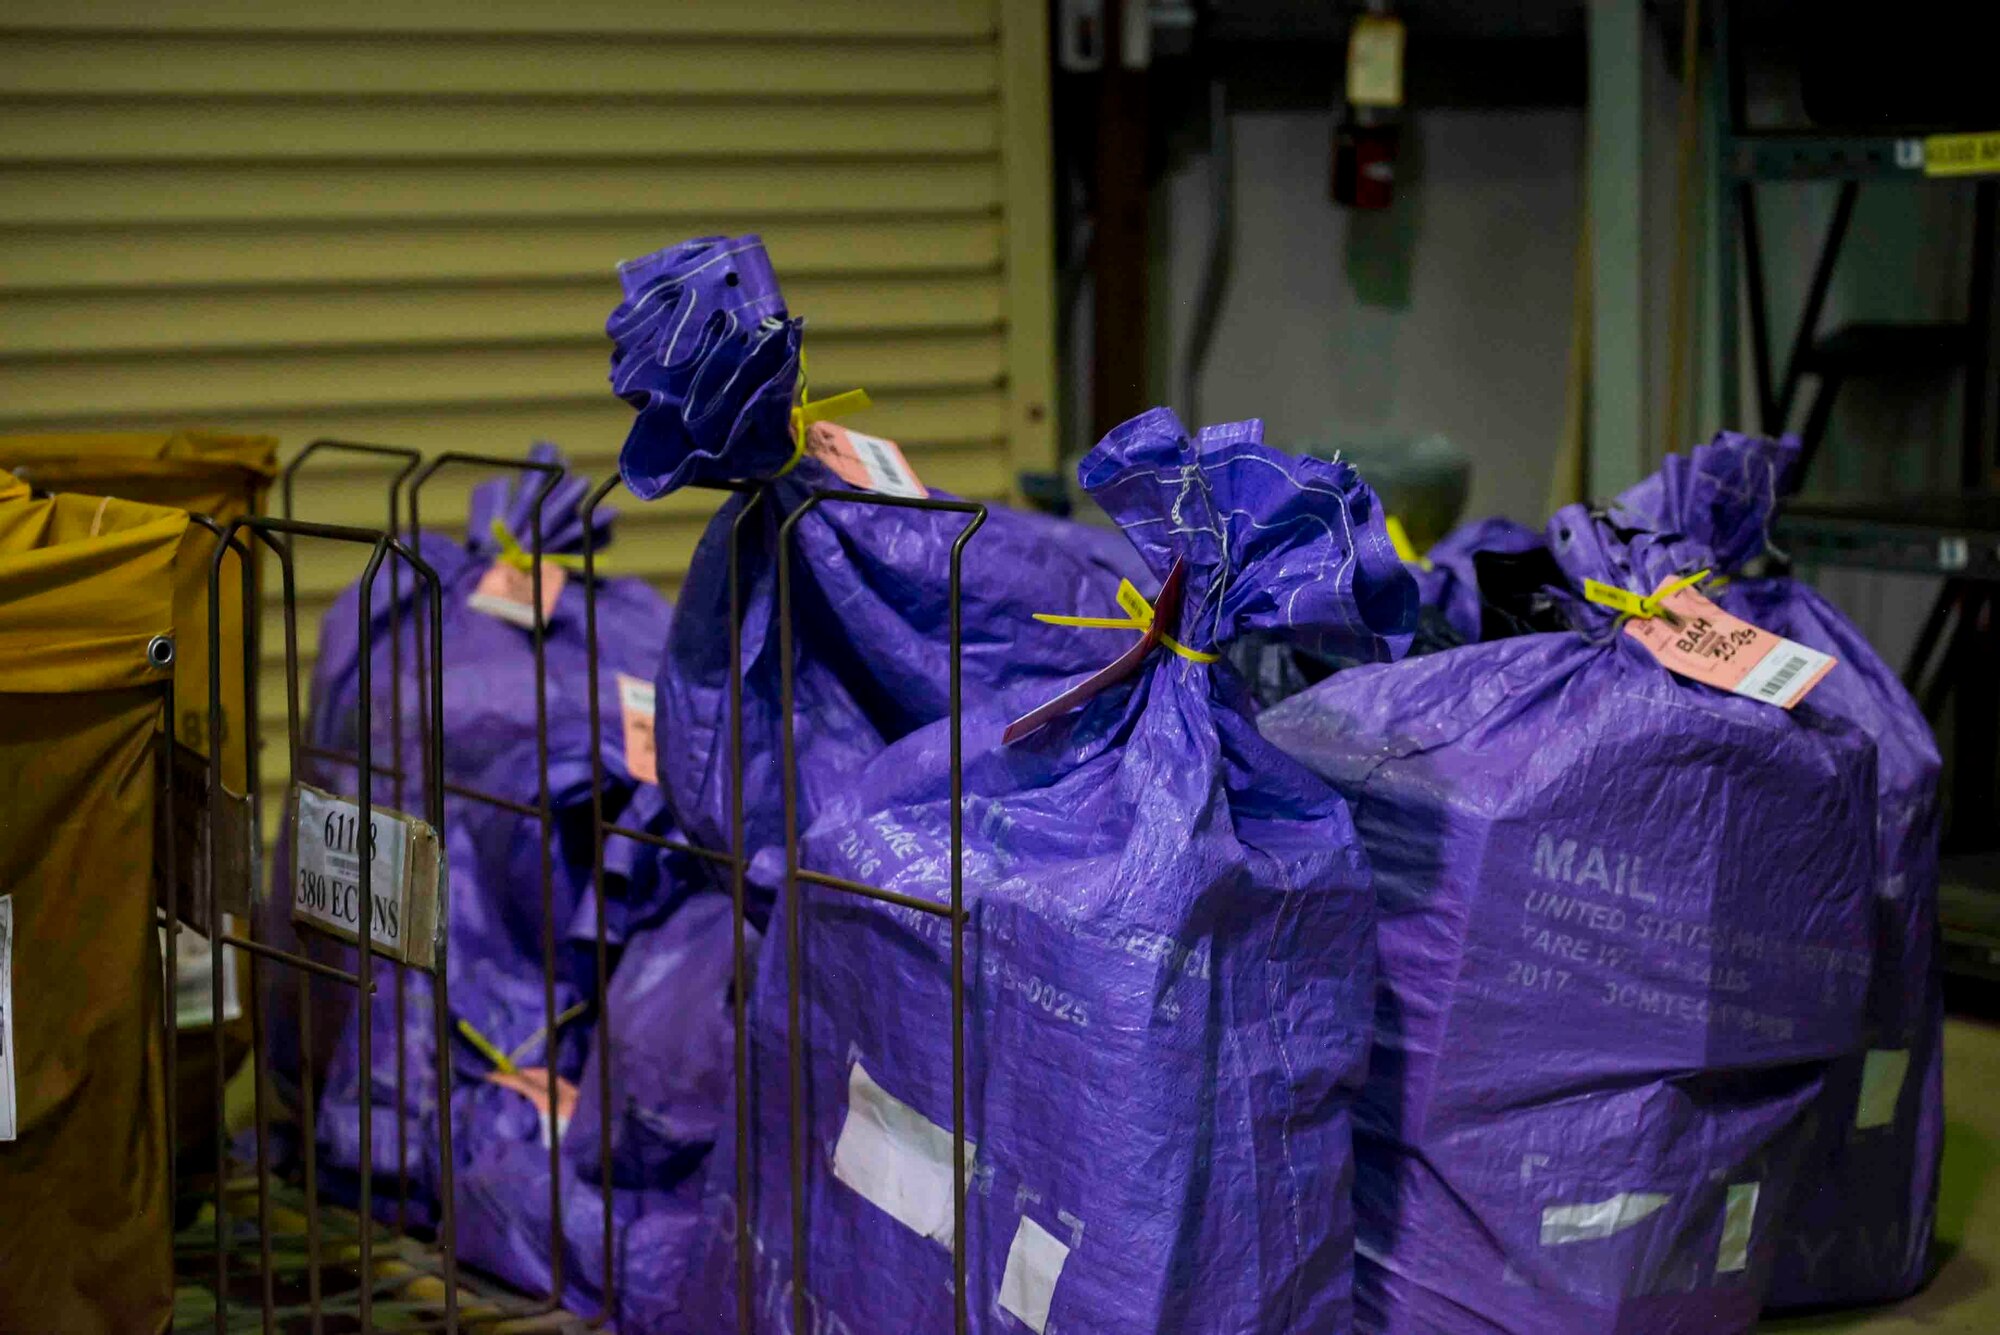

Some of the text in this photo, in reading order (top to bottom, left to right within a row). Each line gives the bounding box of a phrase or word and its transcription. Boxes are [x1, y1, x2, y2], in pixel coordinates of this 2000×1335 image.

[1676, 617, 1712, 653] BAH
[1533, 832, 1657, 903] MAIL
[297, 869, 398, 937] 380 ECNS
[1524, 889, 1627, 933] UNITED
[1506, 960, 1572, 992] 2017
